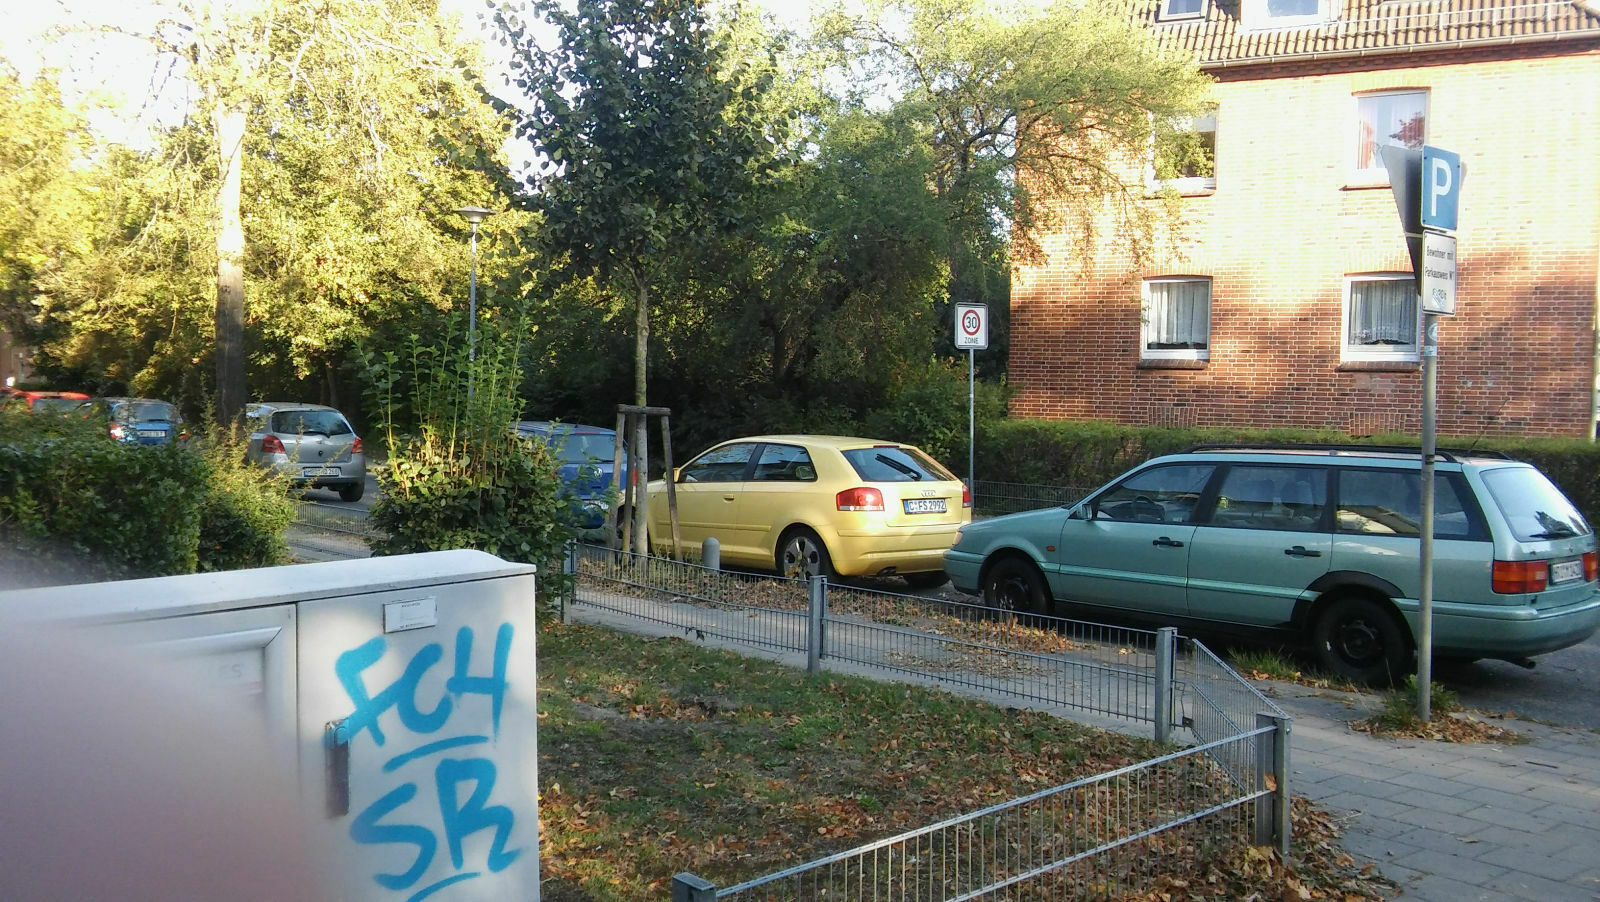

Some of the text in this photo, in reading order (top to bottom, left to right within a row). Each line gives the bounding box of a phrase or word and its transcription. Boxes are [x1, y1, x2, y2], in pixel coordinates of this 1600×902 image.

[1431, 157, 1452, 217] P
[966, 316, 977, 328] 30
[964, 336, 979, 344] ZONE
